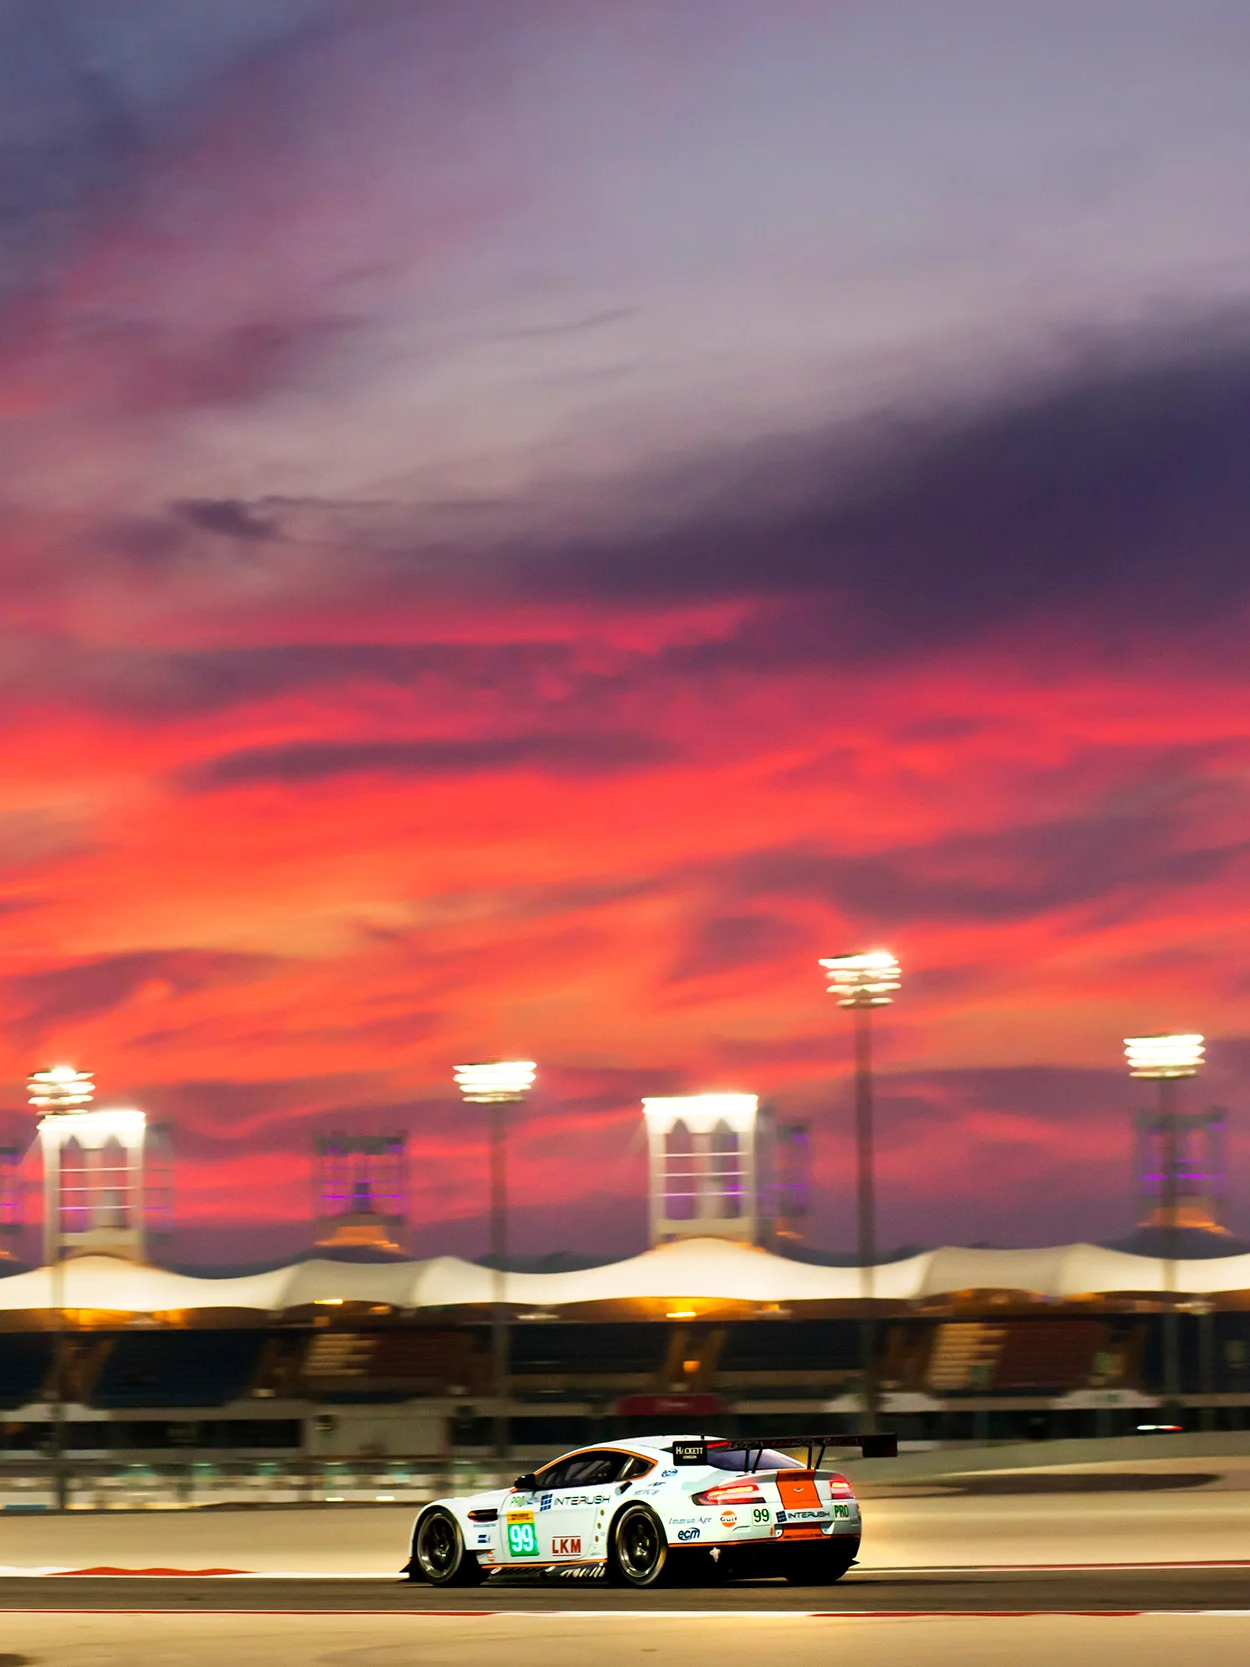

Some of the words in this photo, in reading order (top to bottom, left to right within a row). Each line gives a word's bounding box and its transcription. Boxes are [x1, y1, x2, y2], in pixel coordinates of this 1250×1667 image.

[554, 1495, 610, 1506] INTERUSH
[753, 1508, 770, 1523] 99
[787, 1510, 830, 1519] INTERUSH
[834, 1505, 849, 1518] PRO
[510, 1524, 534, 1552] 99
[677, 1527, 701, 1541] ecm
[552, 1538, 581, 1554] LKM
